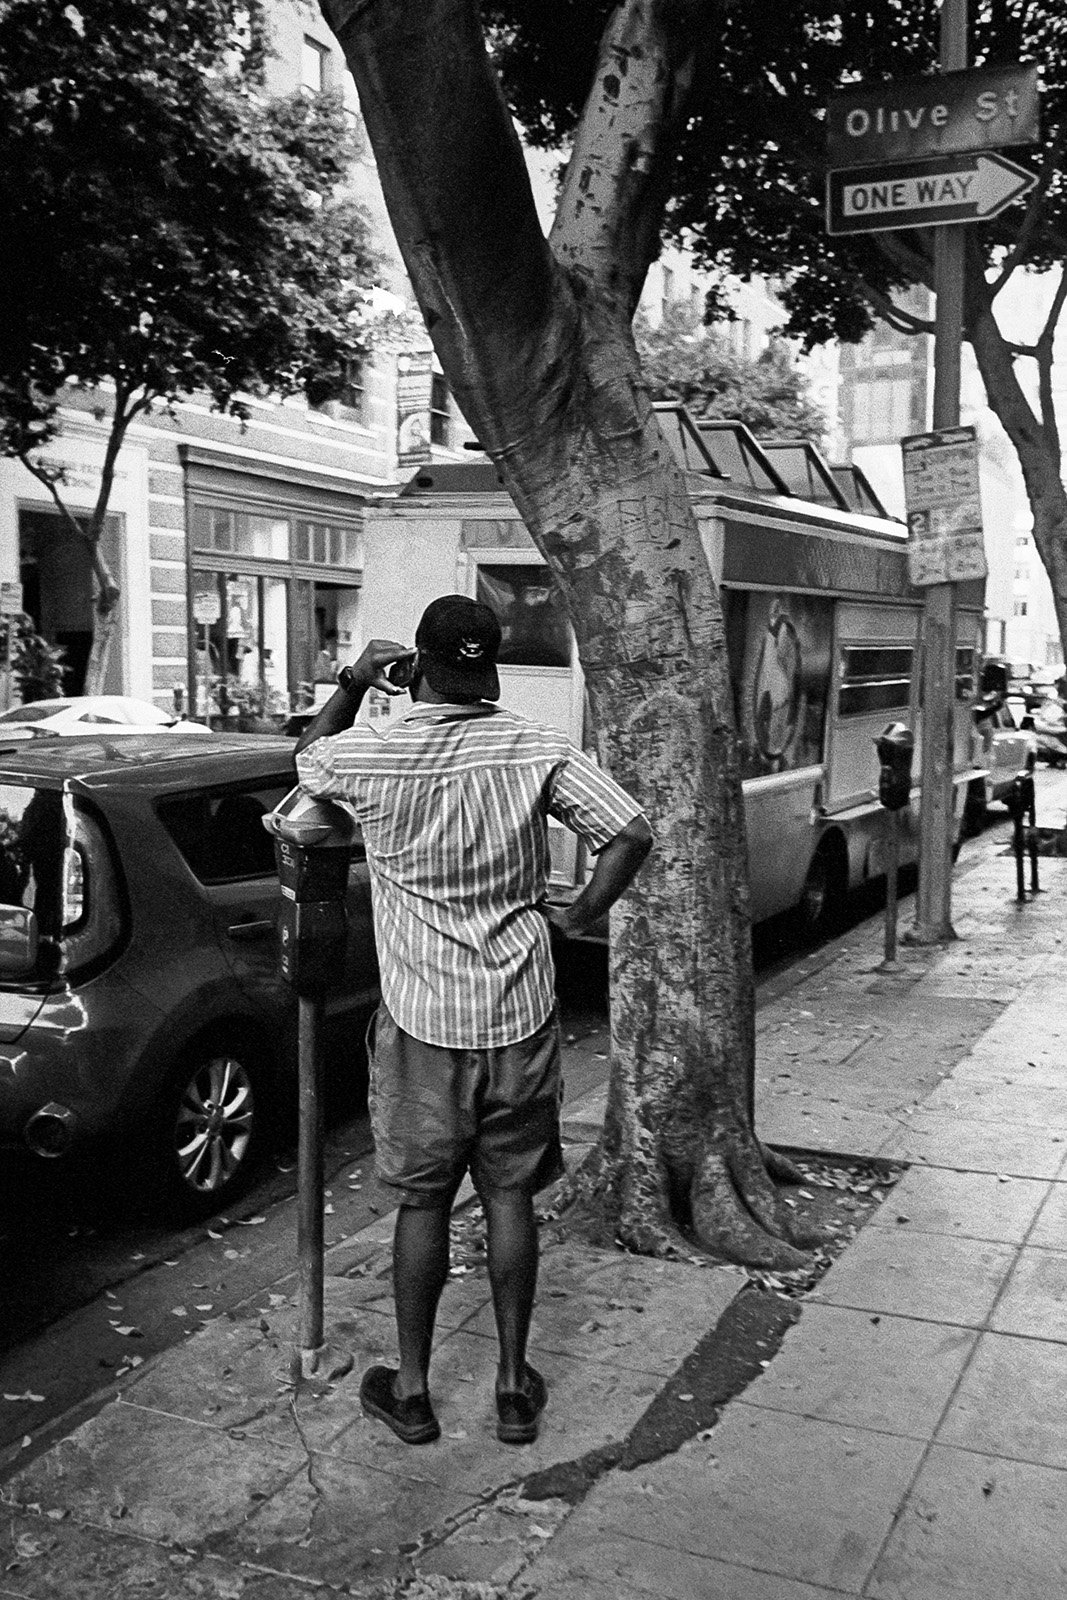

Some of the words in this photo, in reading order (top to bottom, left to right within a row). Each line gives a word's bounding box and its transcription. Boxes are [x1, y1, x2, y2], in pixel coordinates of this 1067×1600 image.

[846, 104, 948, 137] Olive
[976, 91, 1019, 121] St
[851, 184, 906, 211] ONE
[917, 175, 974, 203] WAY
